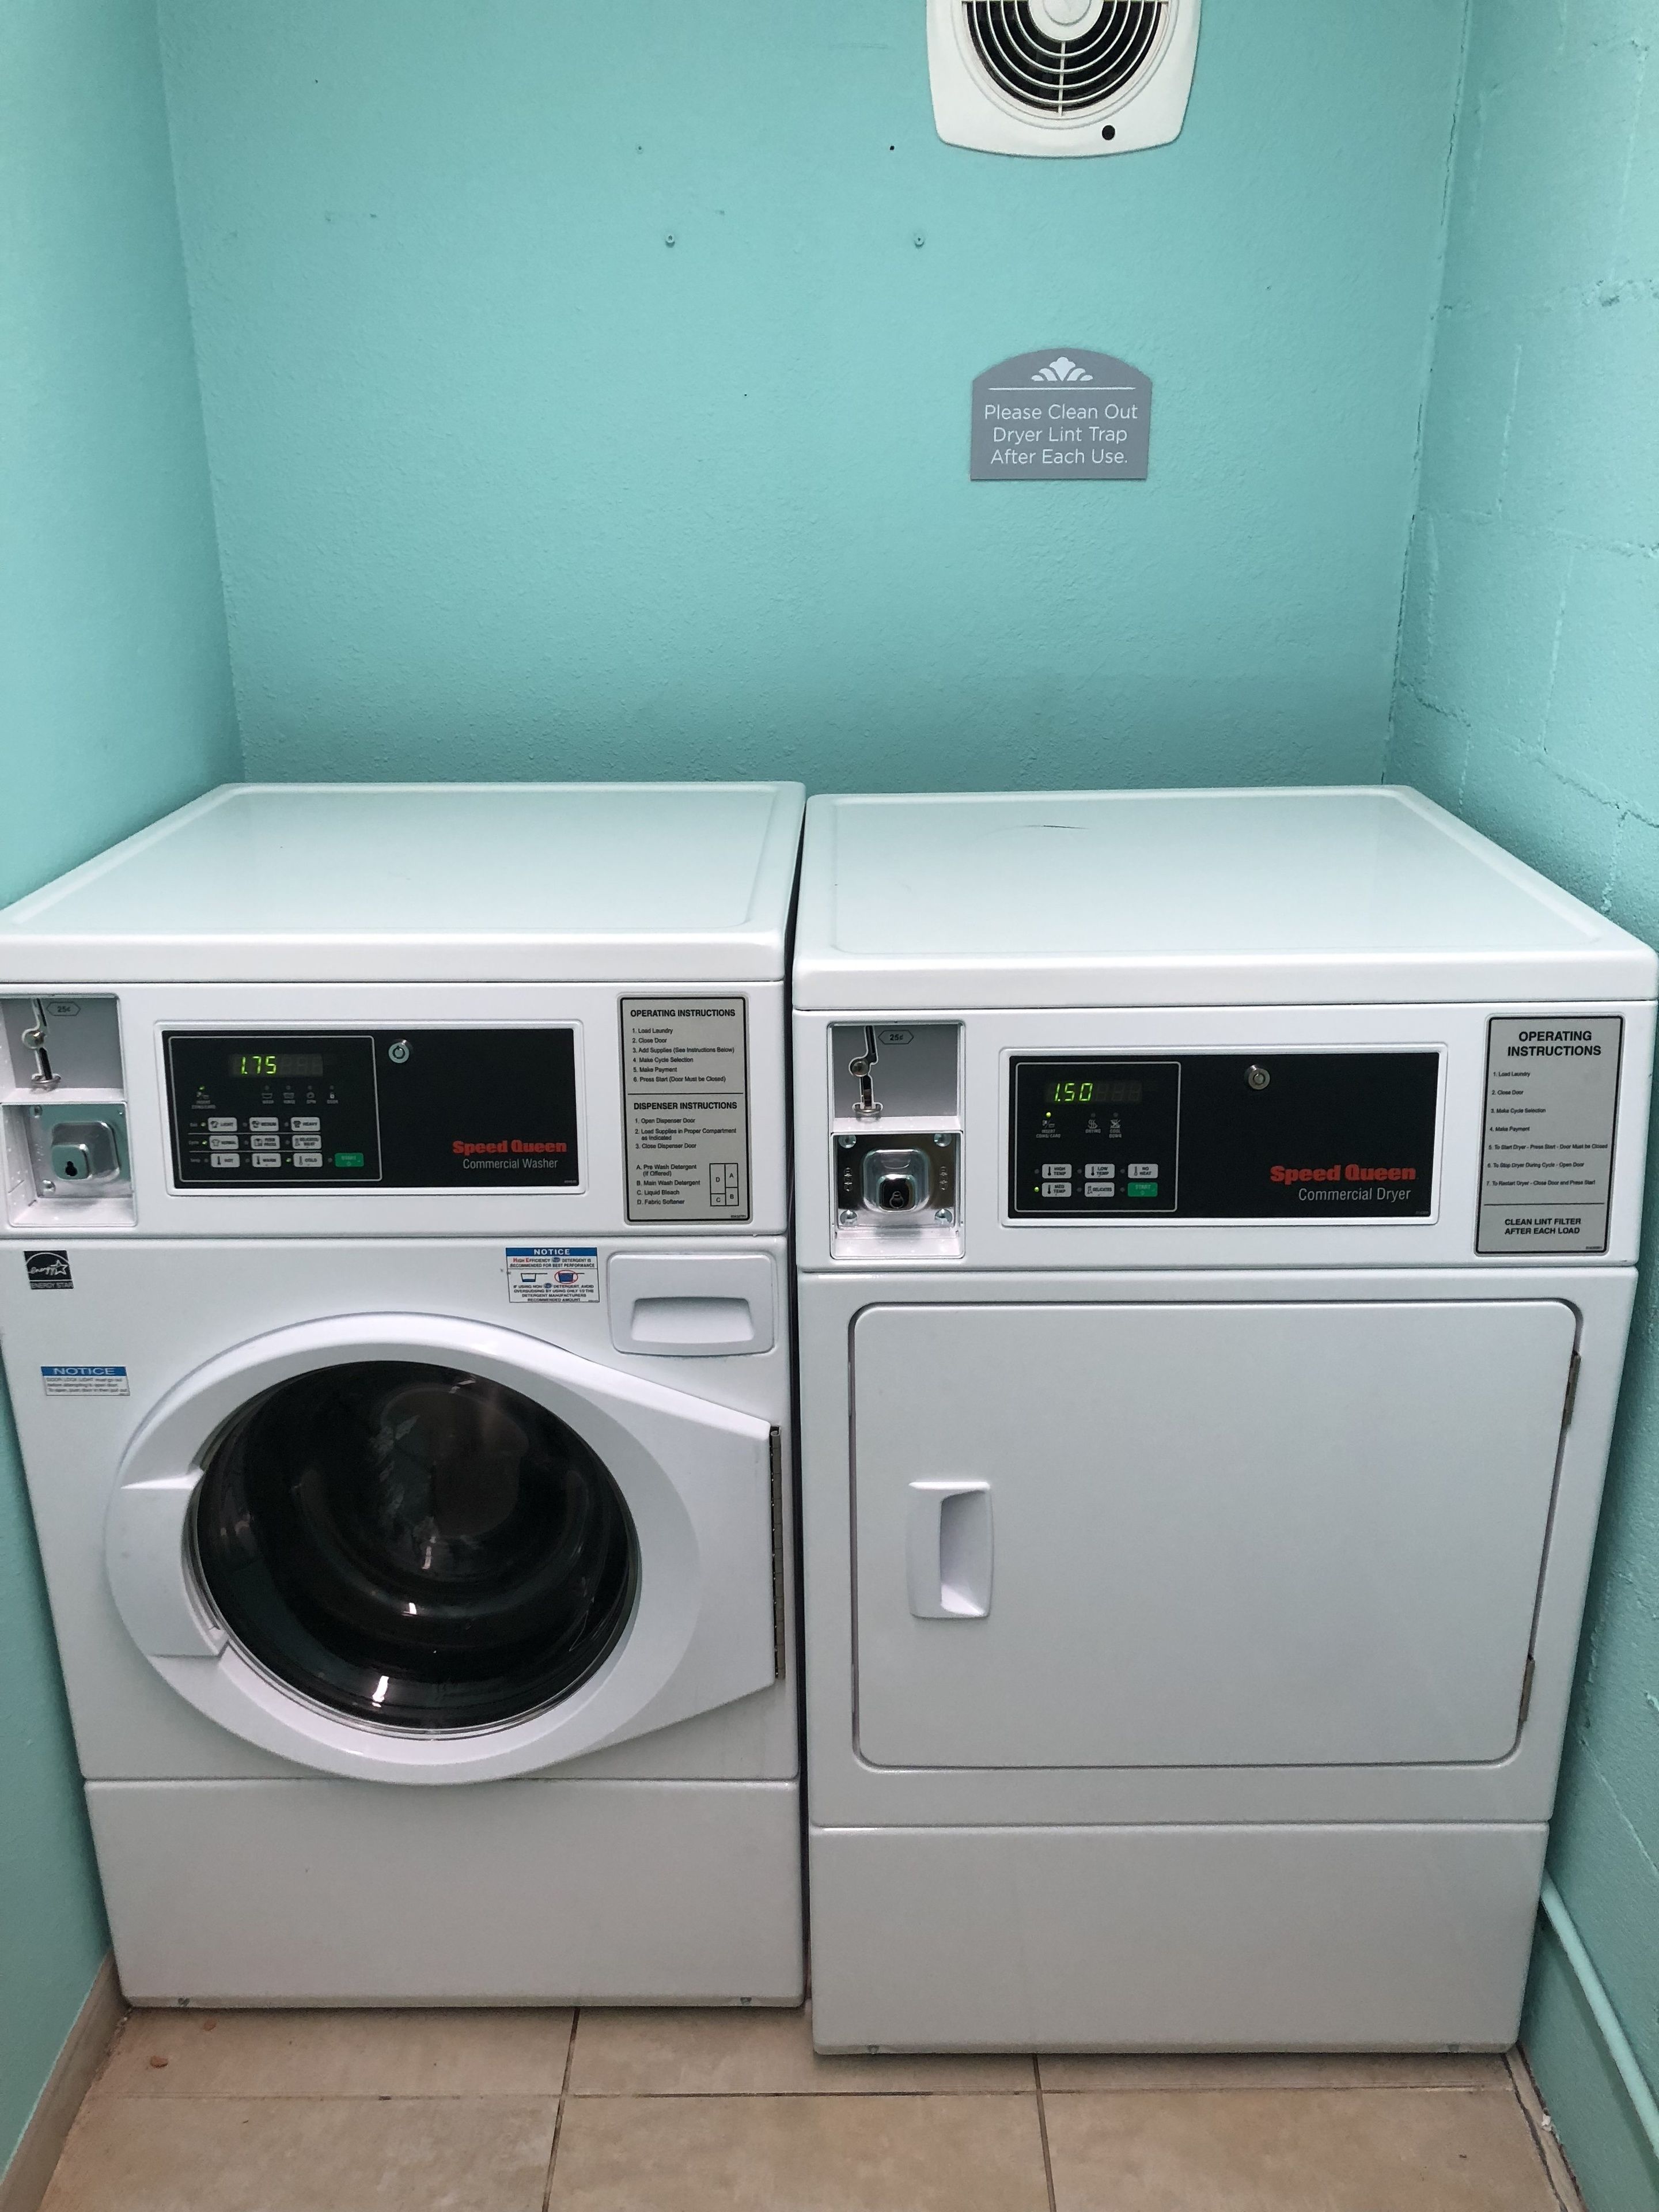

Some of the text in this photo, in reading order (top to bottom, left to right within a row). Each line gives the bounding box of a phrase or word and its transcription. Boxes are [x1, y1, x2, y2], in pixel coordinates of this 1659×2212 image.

[985, 404, 1138, 419] Please Clean Out
[994, 427, 1127, 445] Dryer Lint Trap
[991, 449, 1127, 464] After Each Use.
[1519, 1031, 1592, 1041] OPERATING
[1508, 1046, 1601, 1056] INSTRUCTIONS
[241, 1056, 276, 1074] 1.75
[1054, 1083, 1093, 1101] 1.50
[453, 1140, 566, 1156] Speed Queen
[463, 1158, 558, 1169] Commercial Washer
[1271, 1164, 1416, 1185] Speed Queen
[1299, 1188, 1411, 1202] Commercial Dryer
